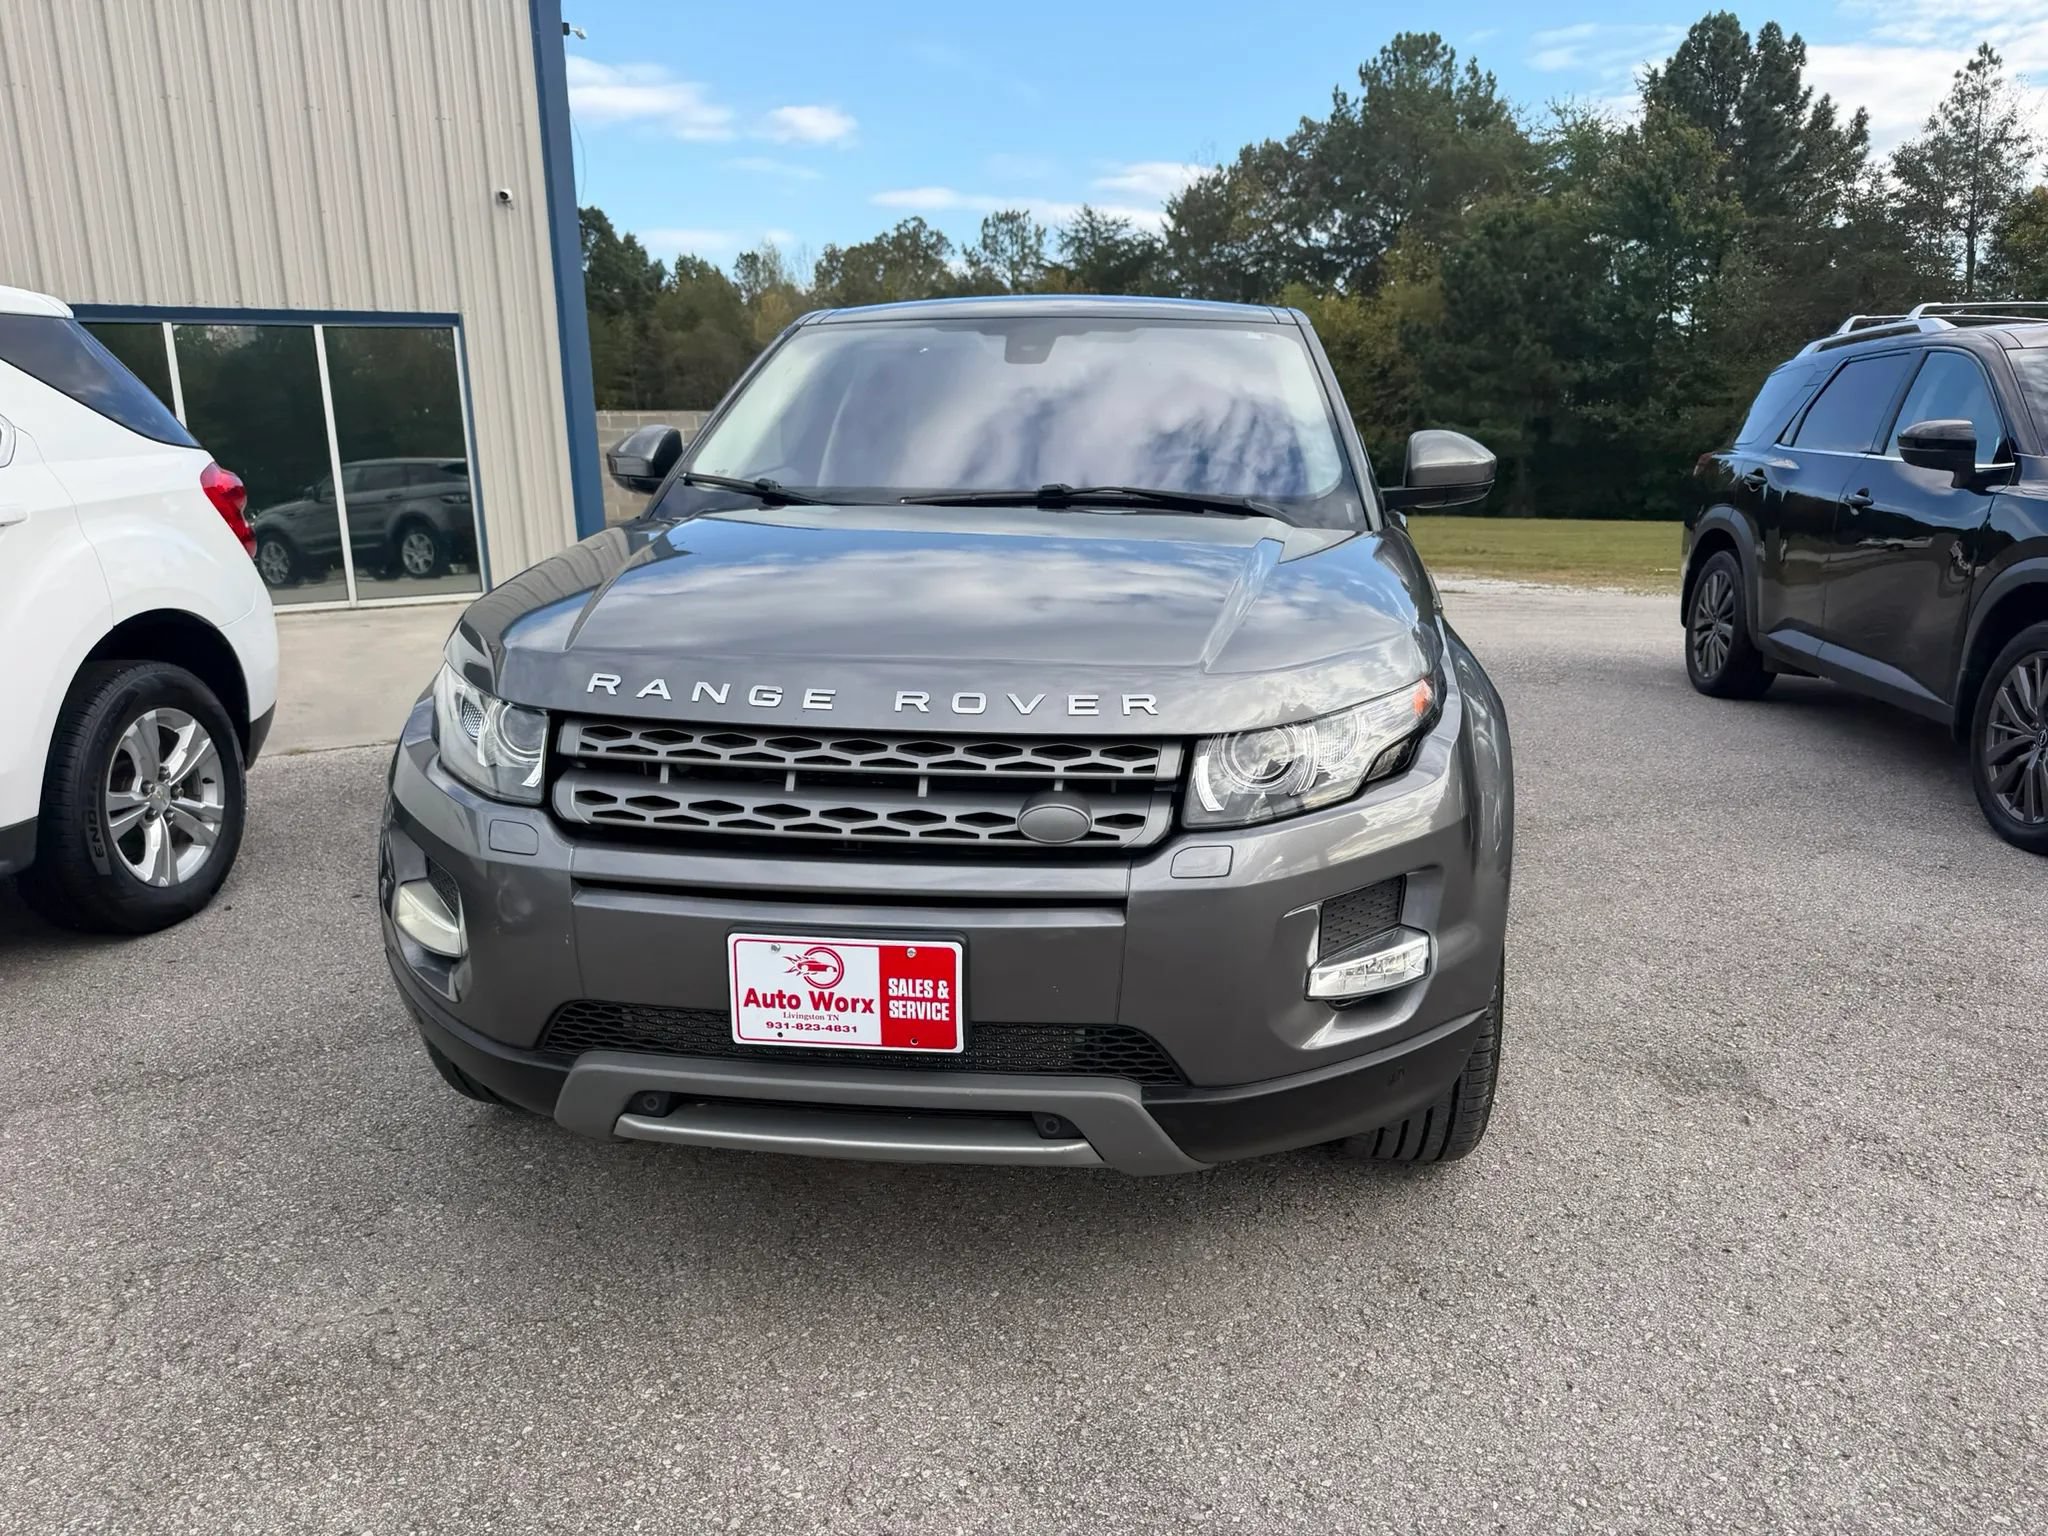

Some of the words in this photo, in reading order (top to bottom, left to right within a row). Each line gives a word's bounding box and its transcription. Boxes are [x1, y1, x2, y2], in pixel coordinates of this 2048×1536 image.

[587, 672, 836, 710] RANGE
[894, 691, 1159, 716] ROVER
[888, 978, 934, 998] SALES
[937, 980, 949, 999] &
[743, 988, 801, 1010] Auto
[808, 991, 874, 1014] Worx
[888, 1000, 950, 1021] SERVICE
[765, 1021, 858, 1033] 931-823-4831
[783, 1011, 825, 1022] Livingston
[827, 1014, 840, 1022] TN
